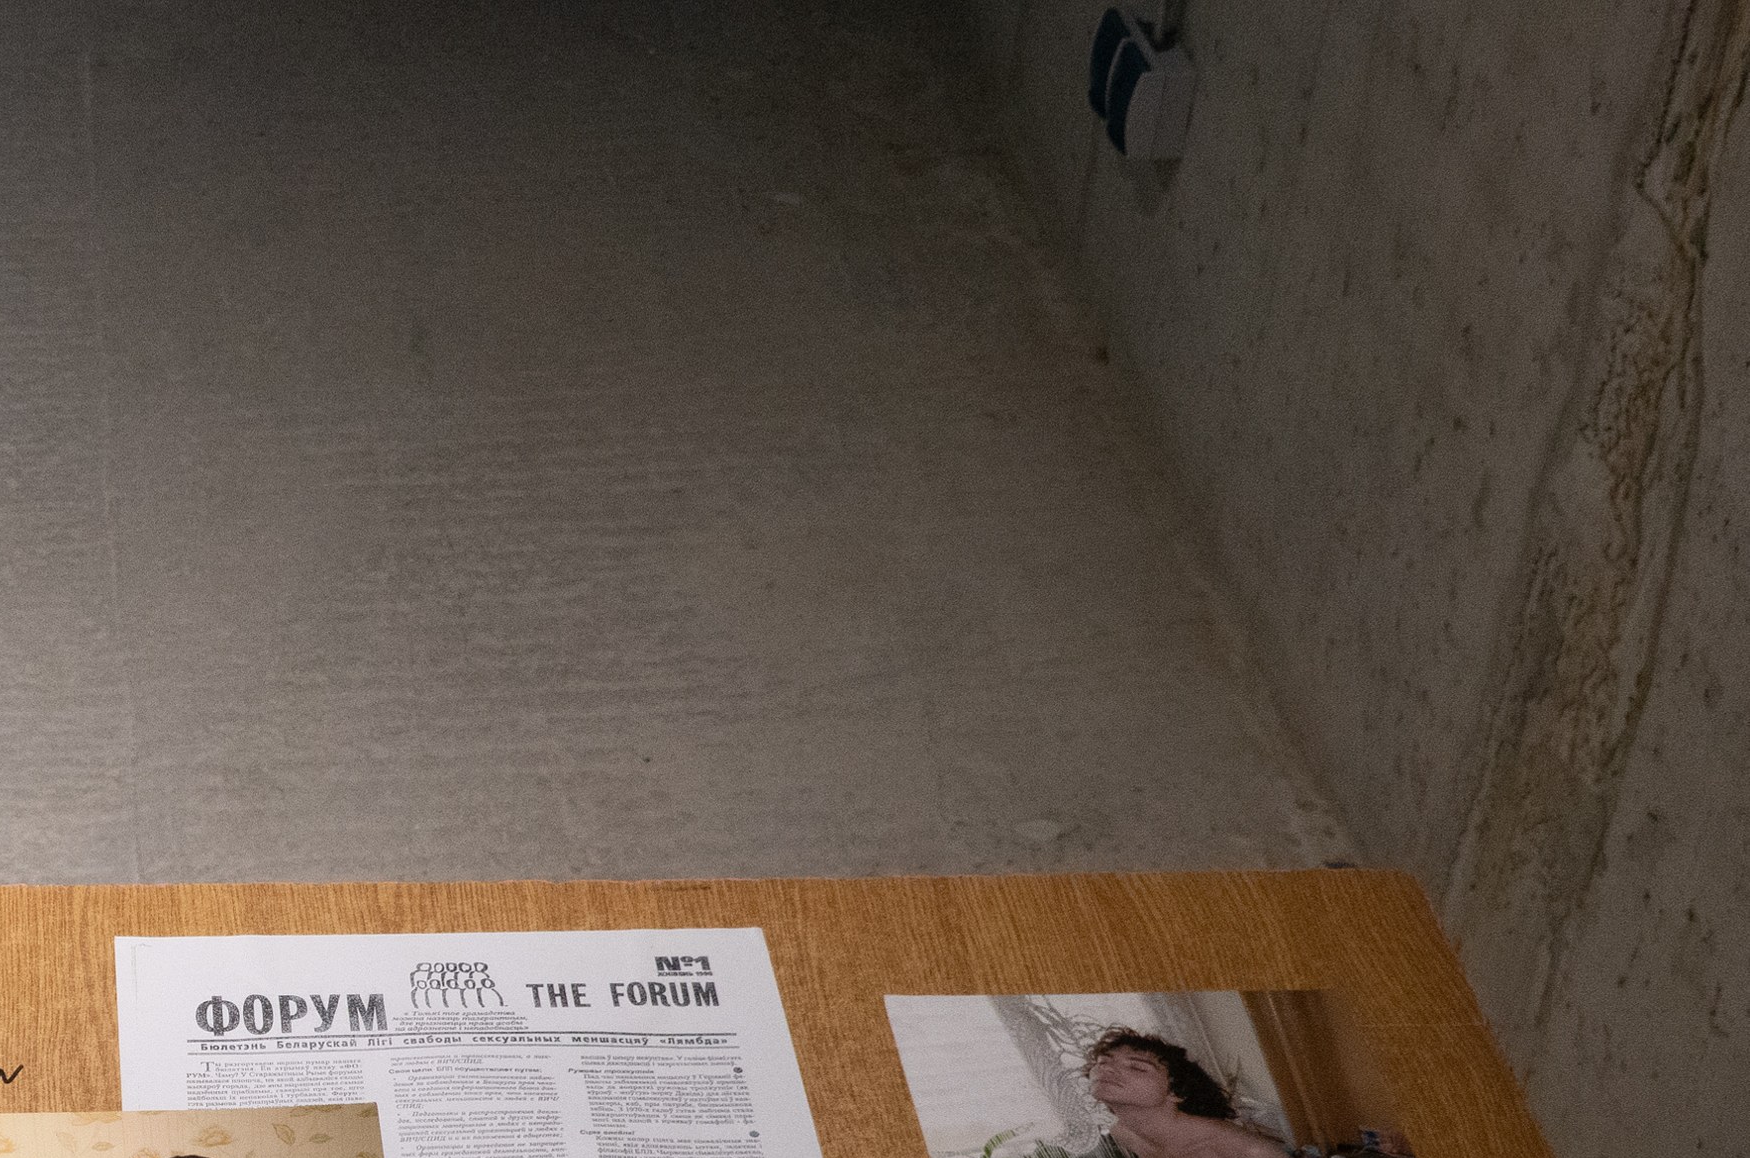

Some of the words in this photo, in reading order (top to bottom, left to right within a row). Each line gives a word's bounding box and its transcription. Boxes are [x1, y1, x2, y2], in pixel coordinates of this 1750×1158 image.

[527, 983, 592, 1008] THE
[610, 981, 720, 1007] FORUM
[195, 993, 389, 1037] ФОРУМ
[367, 1037, 392, 1046] Лігі
[402, 1035, 461, 1044] свабоды
[659, 1036, 727, 1045] «Лямбда»
